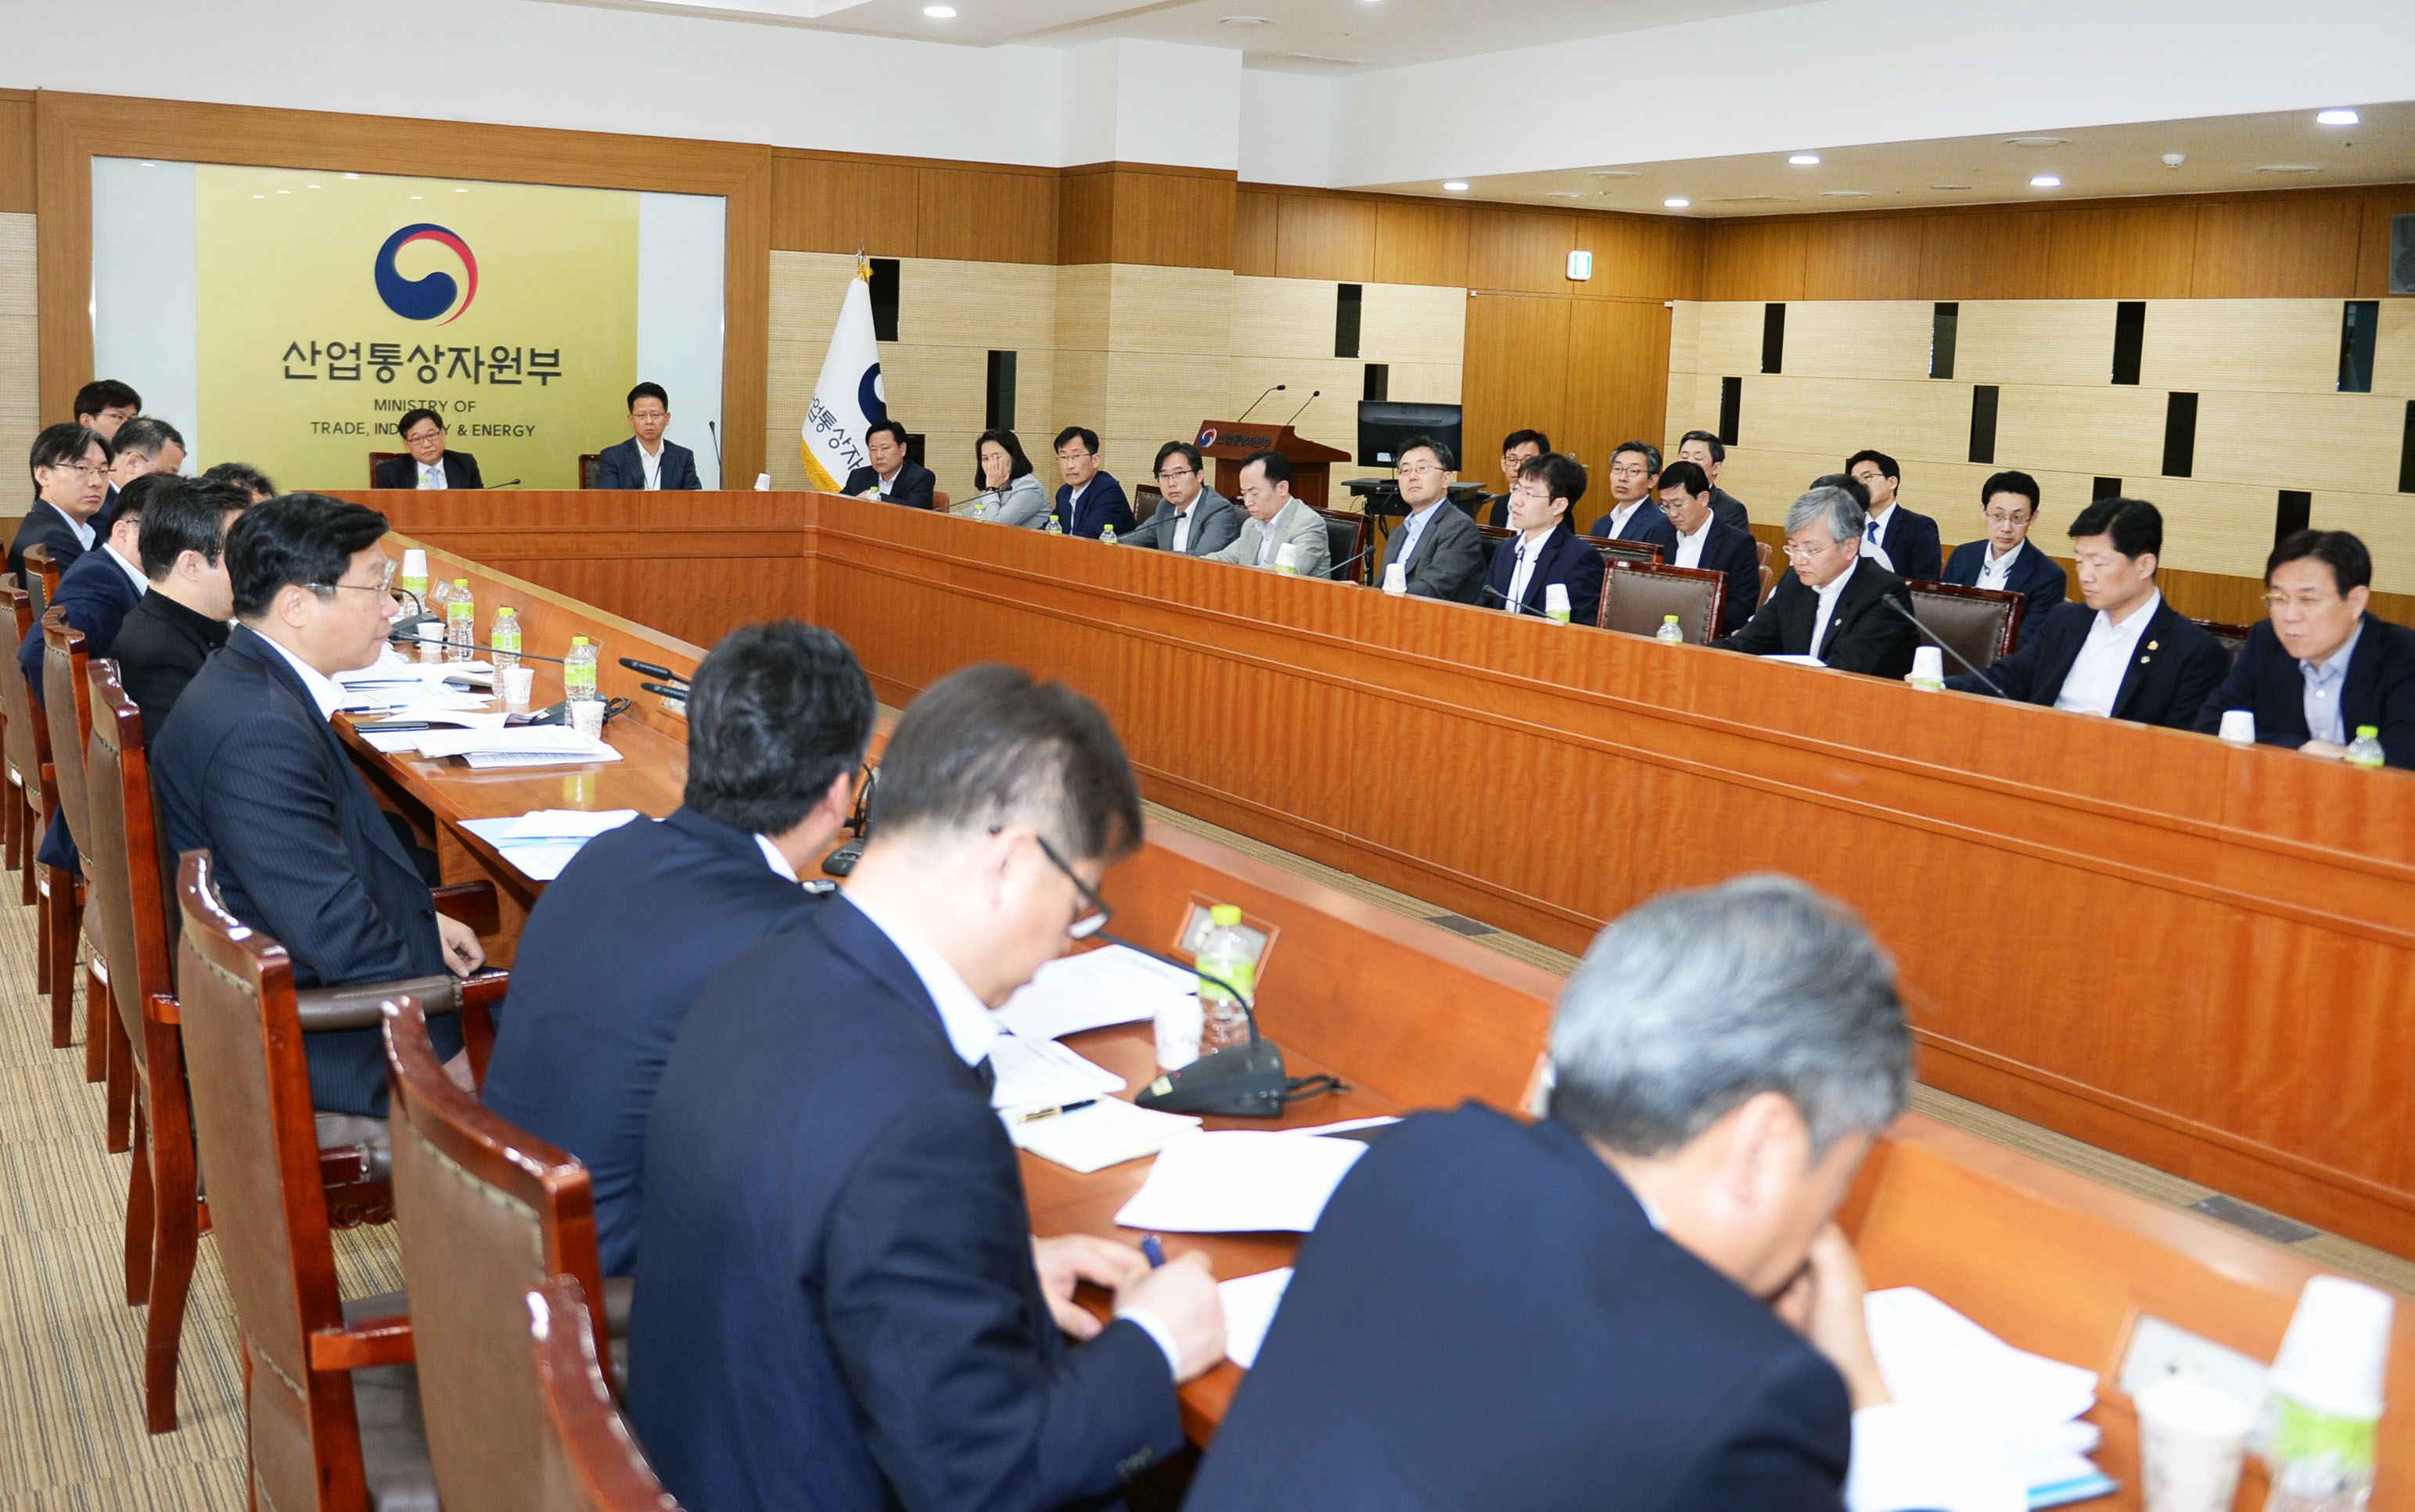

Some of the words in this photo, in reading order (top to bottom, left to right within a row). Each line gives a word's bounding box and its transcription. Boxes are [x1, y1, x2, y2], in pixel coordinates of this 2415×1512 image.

[282, 340, 562, 386] 산업통상자원부
[374, 399, 448, 413] MINISTRY
[454, 400, 476, 413] OF
[311, 422, 369, 436] TRADE,
[375, 422, 451, 436] INDY
[457, 423, 468, 436] &
[472, 424, 536, 437] ENERGY
[808, 397, 864, 471] 업통상자
